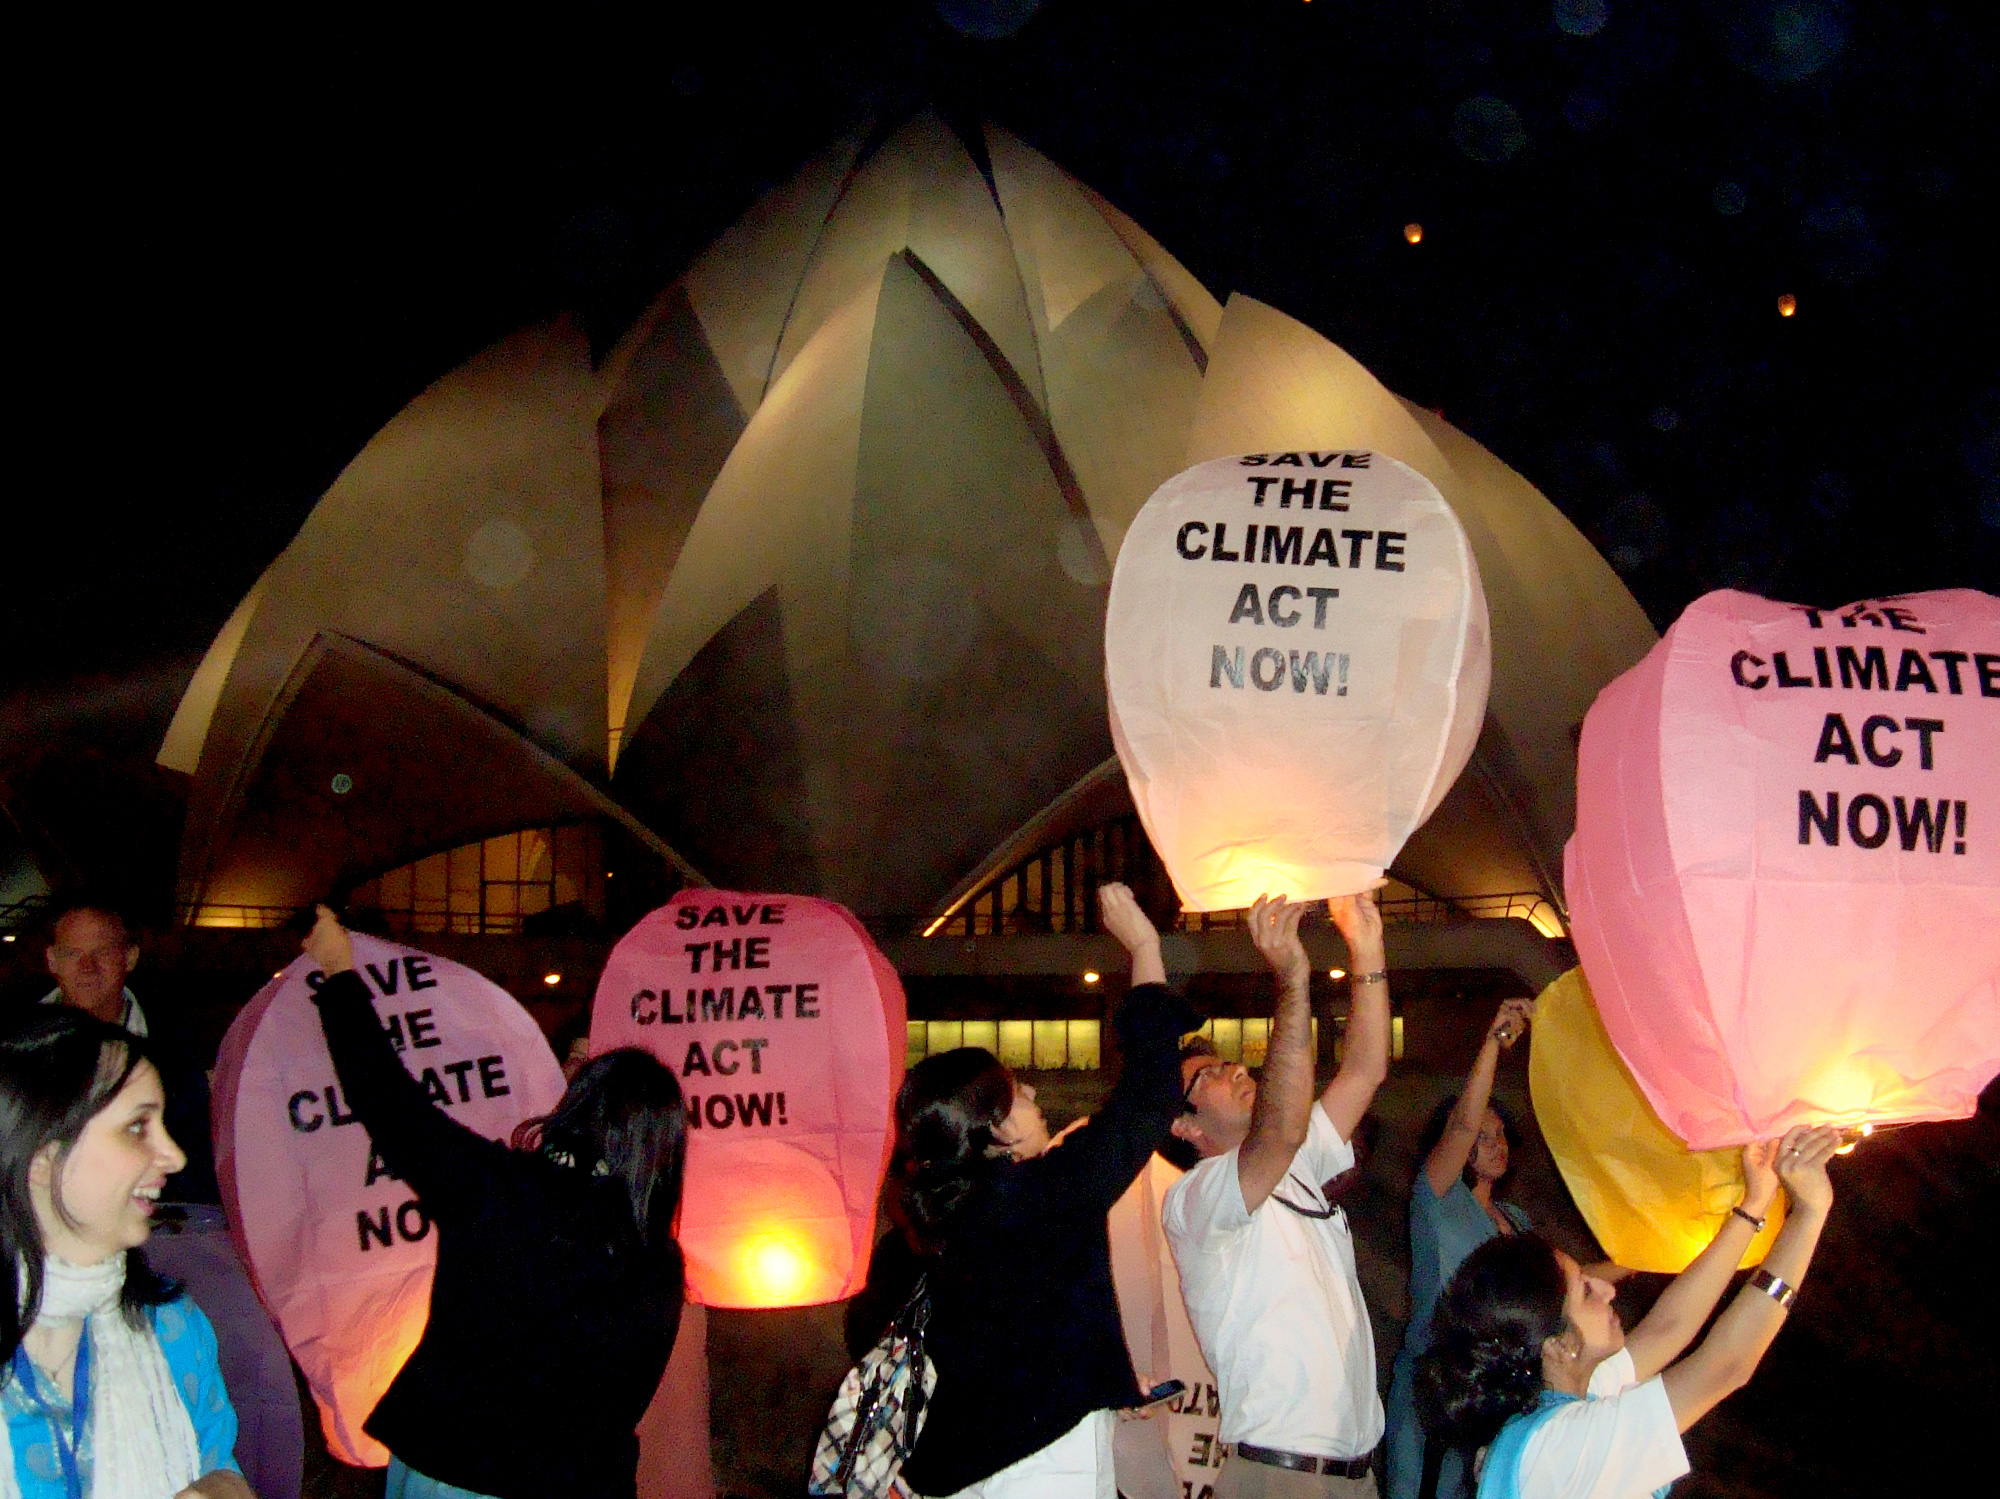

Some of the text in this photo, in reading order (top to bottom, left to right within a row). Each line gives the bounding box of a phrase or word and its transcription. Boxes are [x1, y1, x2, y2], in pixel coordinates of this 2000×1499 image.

[1239, 451, 1373, 469] SAVE
[1247, 475, 1353, 513] THE
[1176, 521, 1408, 573] CLIMATE
[1227, 583, 1340, 630] ACT
[1209, 645, 1350, 697] NOW!
[1730, 645, 2000, 698] CLIMATE
[1814, 713, 1944, 770] ACT
[1798, 789, 1967, 856] NOW!
[676, 903, 786, 930] SAVE
[685, 937, 771, 973] THE
[306, 956, 437, 1004] SVE
[631, 983, 821, 1025] CLIMATE
[383, 1008, 441, 1052] HE
[682, 1038, 768, 1077] ACT
[287, 1055, 510, 1133] CLATE
